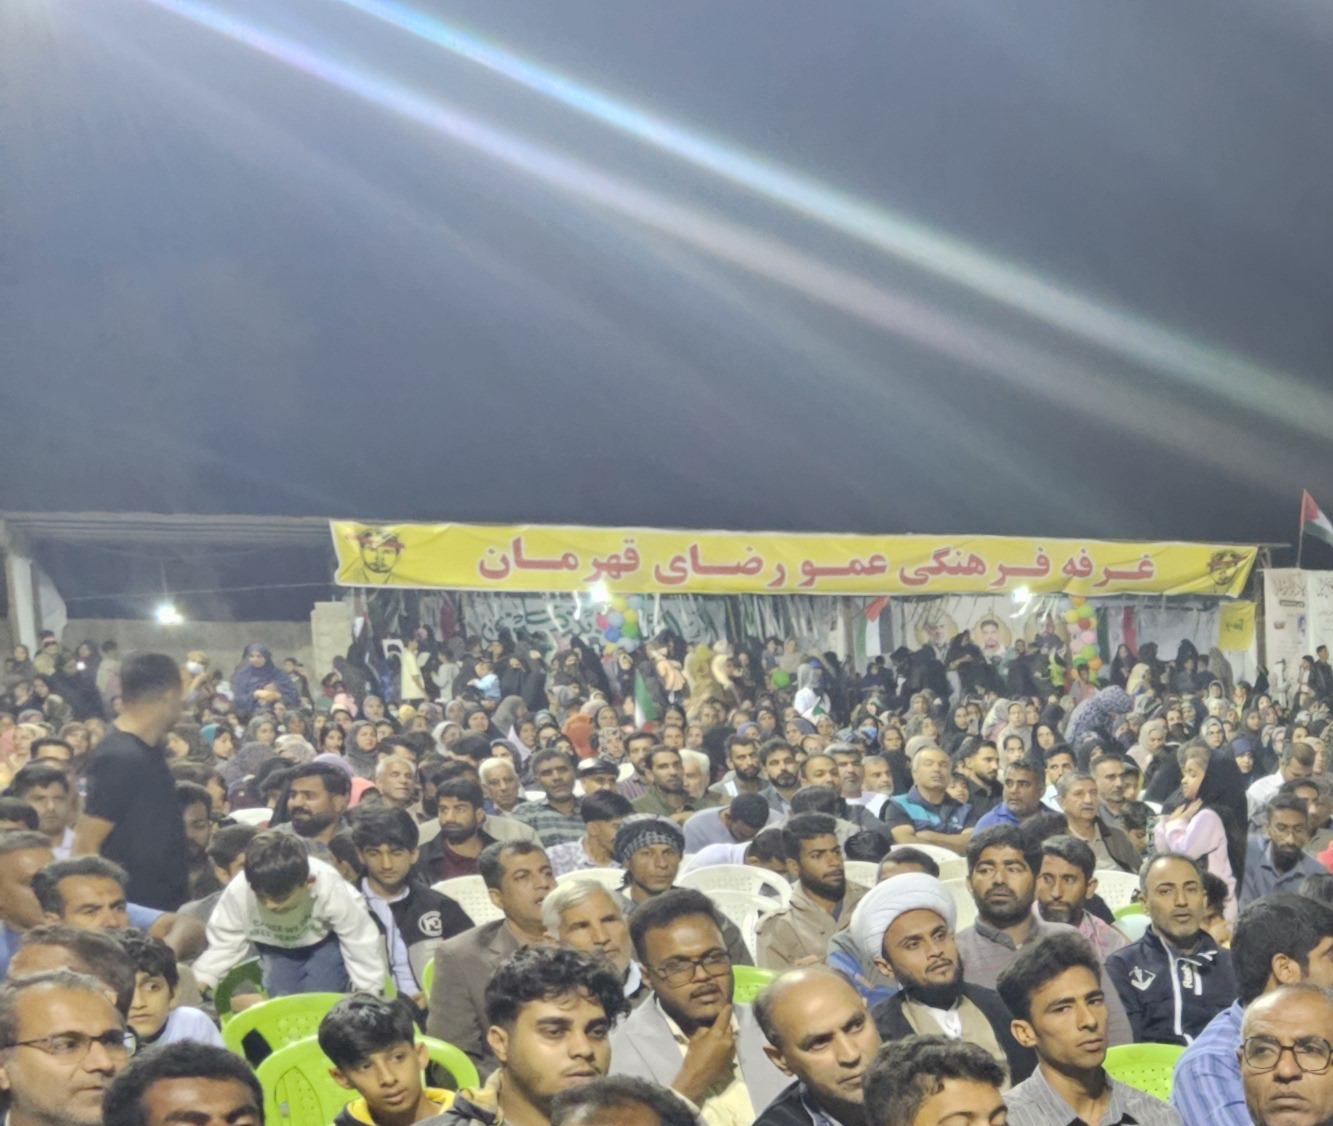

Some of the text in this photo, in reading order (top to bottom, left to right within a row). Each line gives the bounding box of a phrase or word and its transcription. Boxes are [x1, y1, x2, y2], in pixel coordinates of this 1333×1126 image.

[478, 536, 1155, 588] غرفه فرهنگی عمو رضای قهرمان
